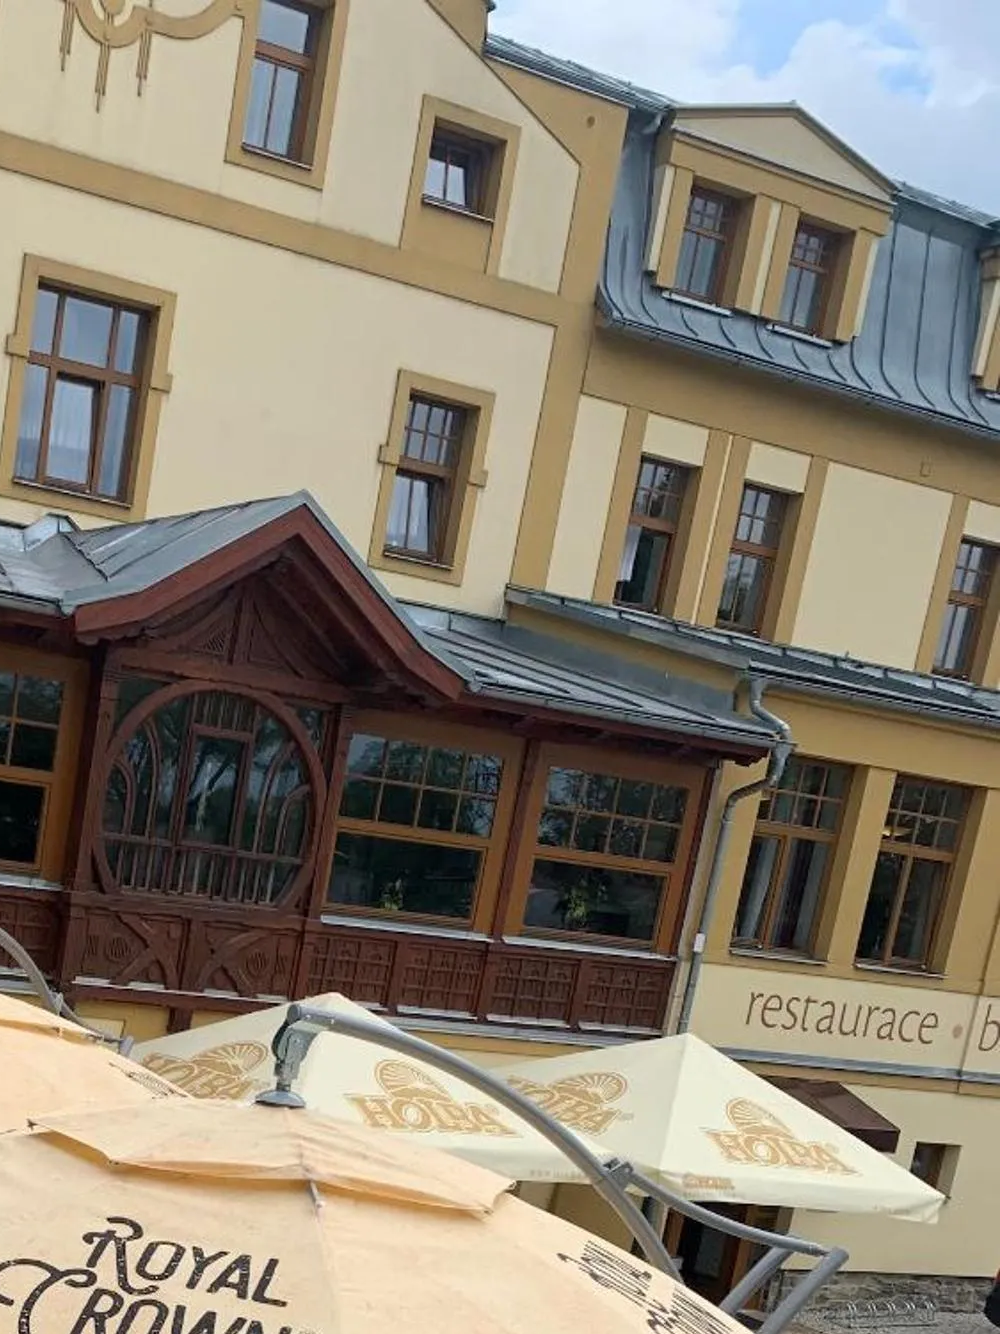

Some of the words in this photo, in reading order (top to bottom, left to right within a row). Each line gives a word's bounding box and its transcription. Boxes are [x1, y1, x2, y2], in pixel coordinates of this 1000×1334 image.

[745, 991, 939, 1045] restaurace
[342, 1093, 524, 1138] HOLBA
[699, 1127, 864, 1176] HOLBA
[82, 1216, 287, 1307] ROYAL
